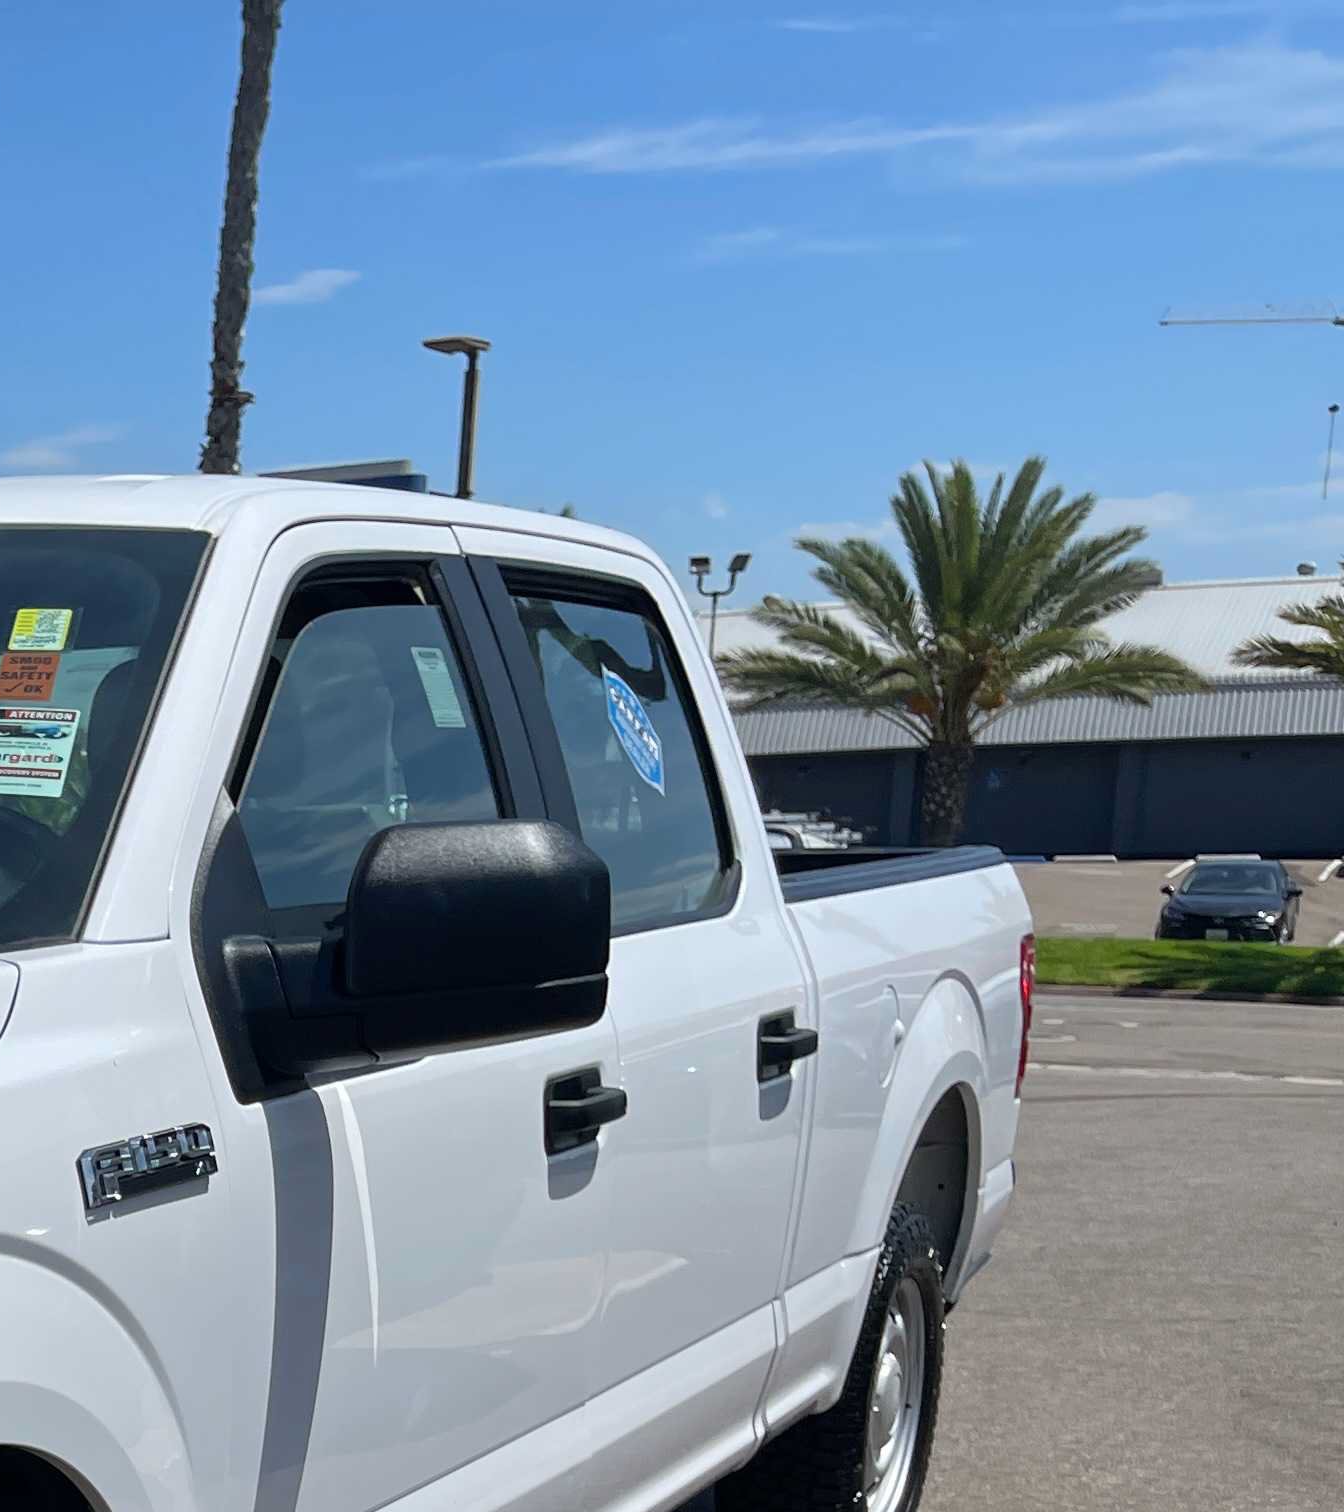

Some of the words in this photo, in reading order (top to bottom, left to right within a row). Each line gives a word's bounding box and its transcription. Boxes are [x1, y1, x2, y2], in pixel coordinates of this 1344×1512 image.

[9, 656, 53, 665] SMOG
[0, 671, 54, 680] SAFETY
[23, 684, 44, 693] OK
[9, 710, 73, 720] ATTENTION
